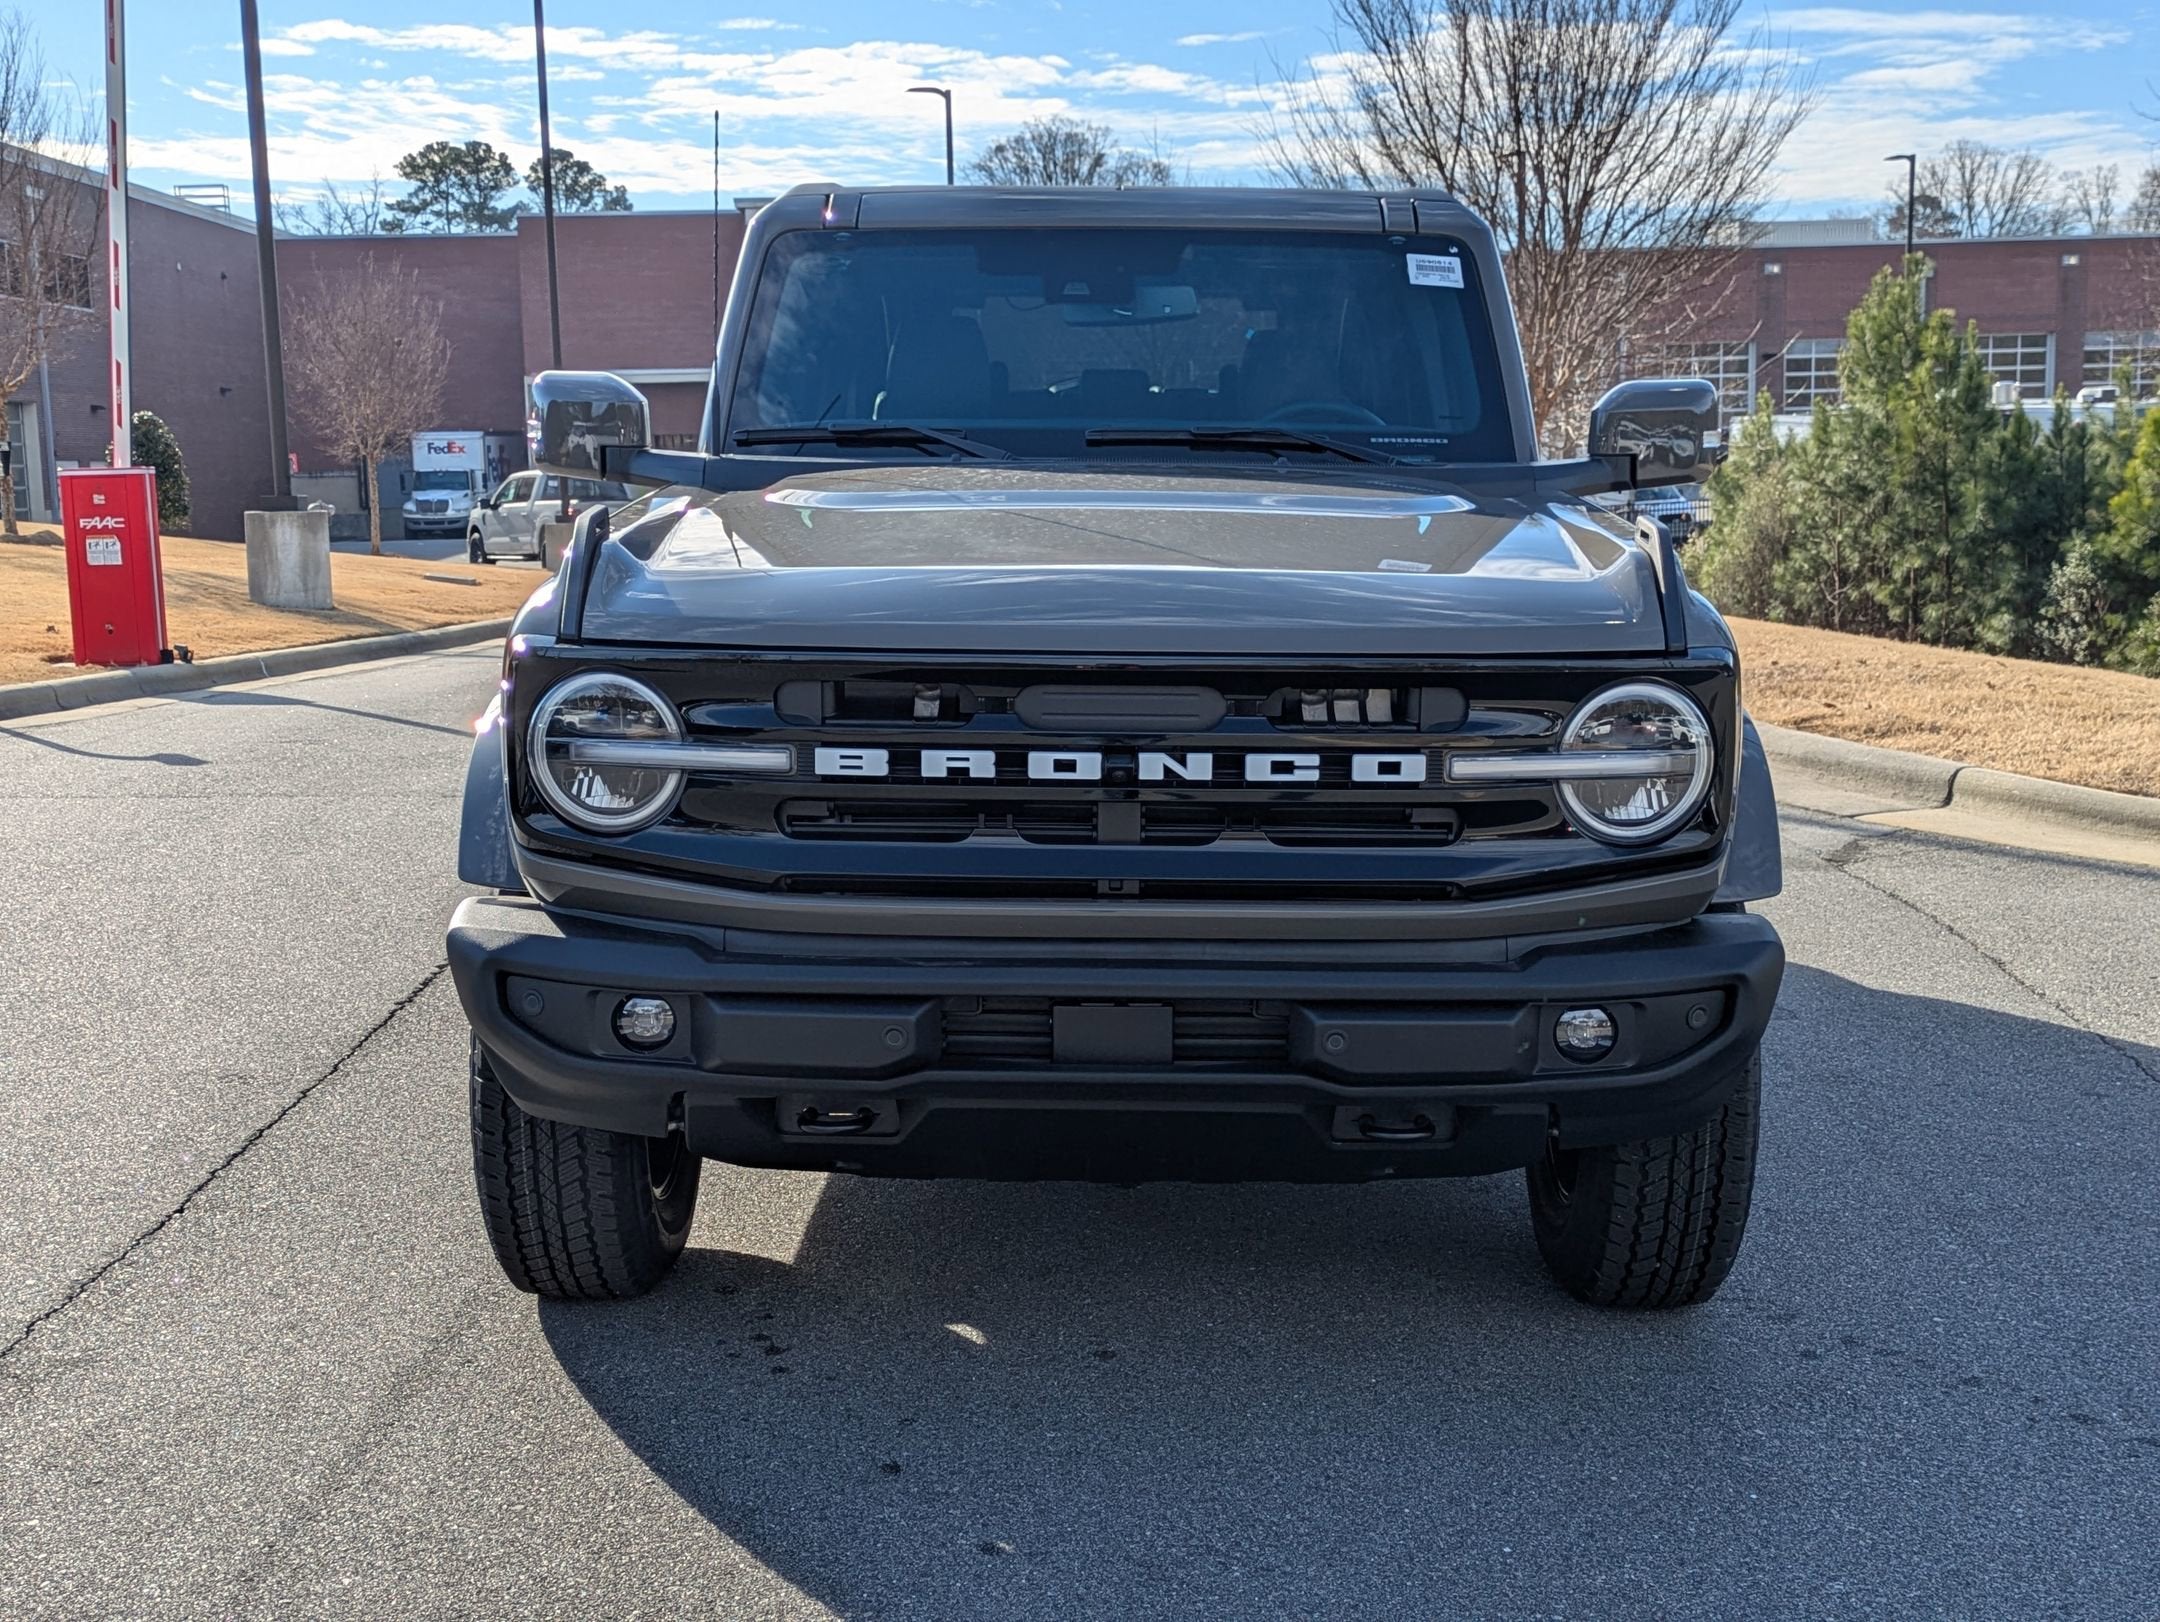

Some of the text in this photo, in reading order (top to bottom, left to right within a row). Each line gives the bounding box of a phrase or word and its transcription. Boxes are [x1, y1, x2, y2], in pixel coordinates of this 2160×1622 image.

[427, 441, 466, 455] FedEx
[79, 516, 126, 530] FAAC
[814, 747, 1427, 782] BRONCO
